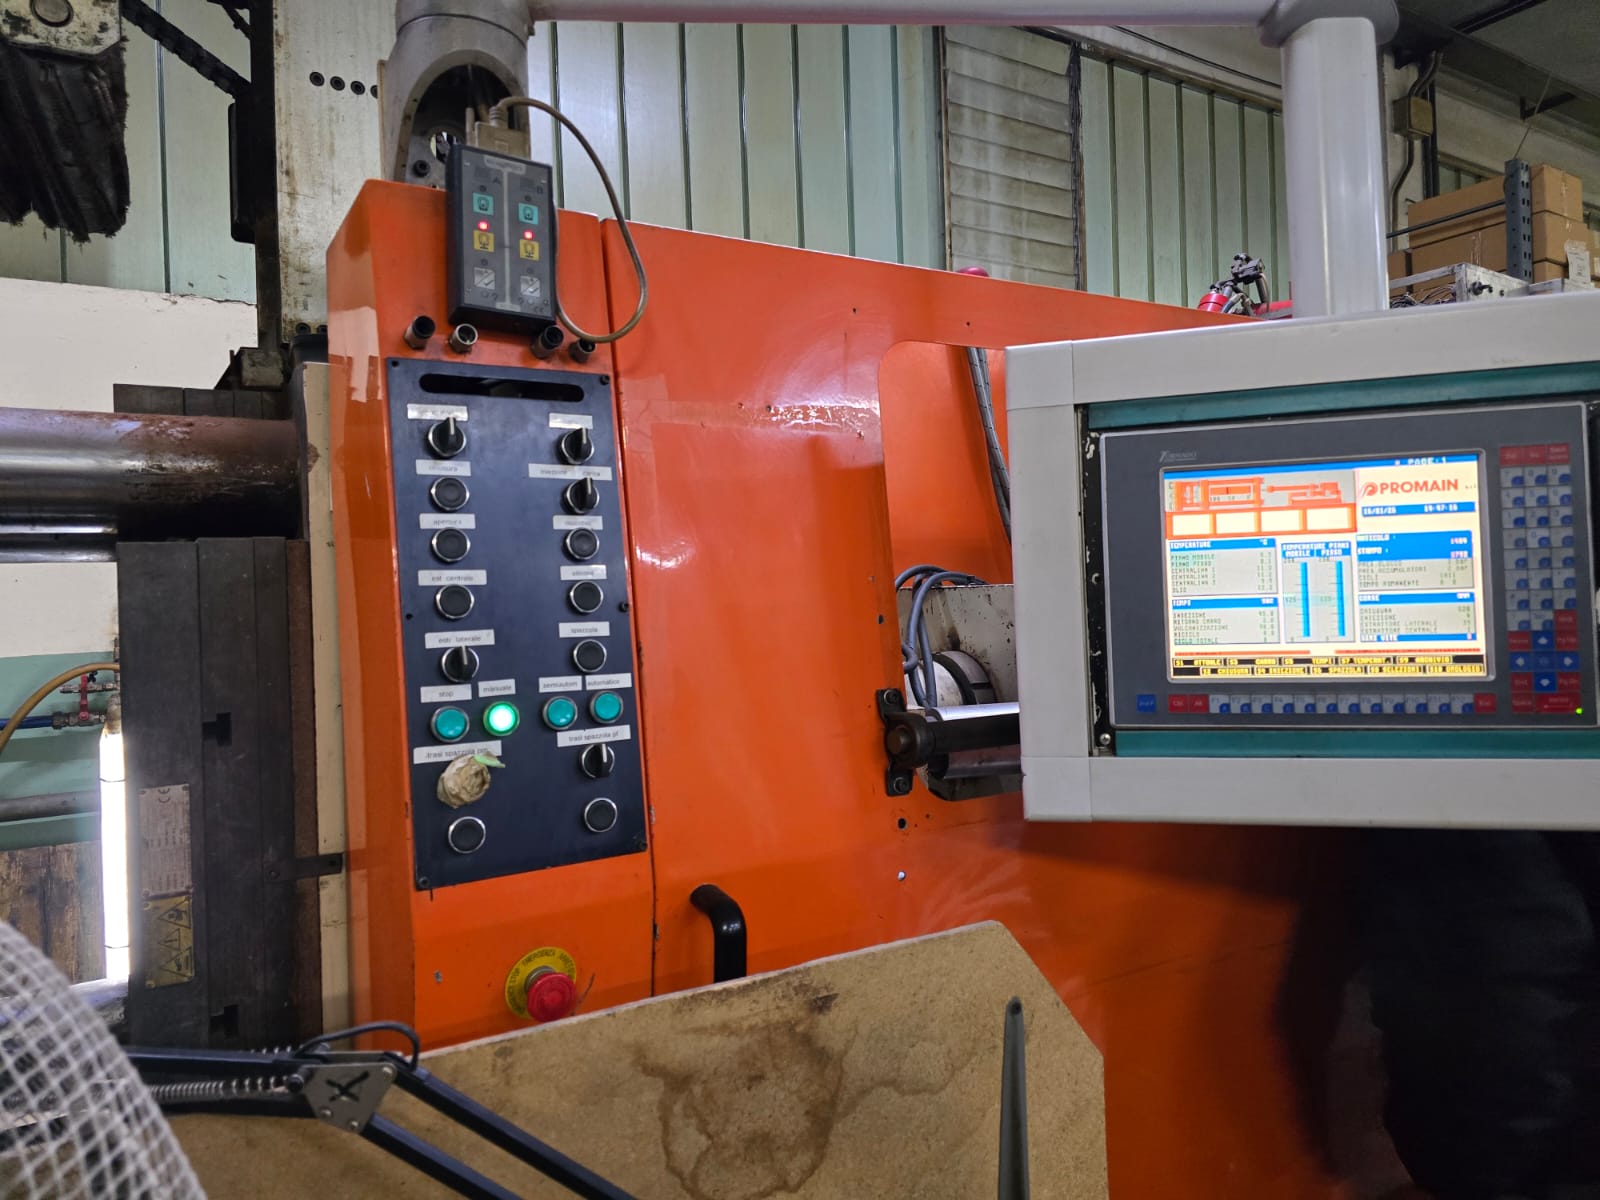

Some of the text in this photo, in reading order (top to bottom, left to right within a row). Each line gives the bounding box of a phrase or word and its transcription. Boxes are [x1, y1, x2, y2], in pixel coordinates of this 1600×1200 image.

[1379, 479, 1459, 495] PROMAIN
[483, 684, 513, 693] manuale
[438, 689, 454, 699] stop
[584, 731, 609, 742] spazzola
